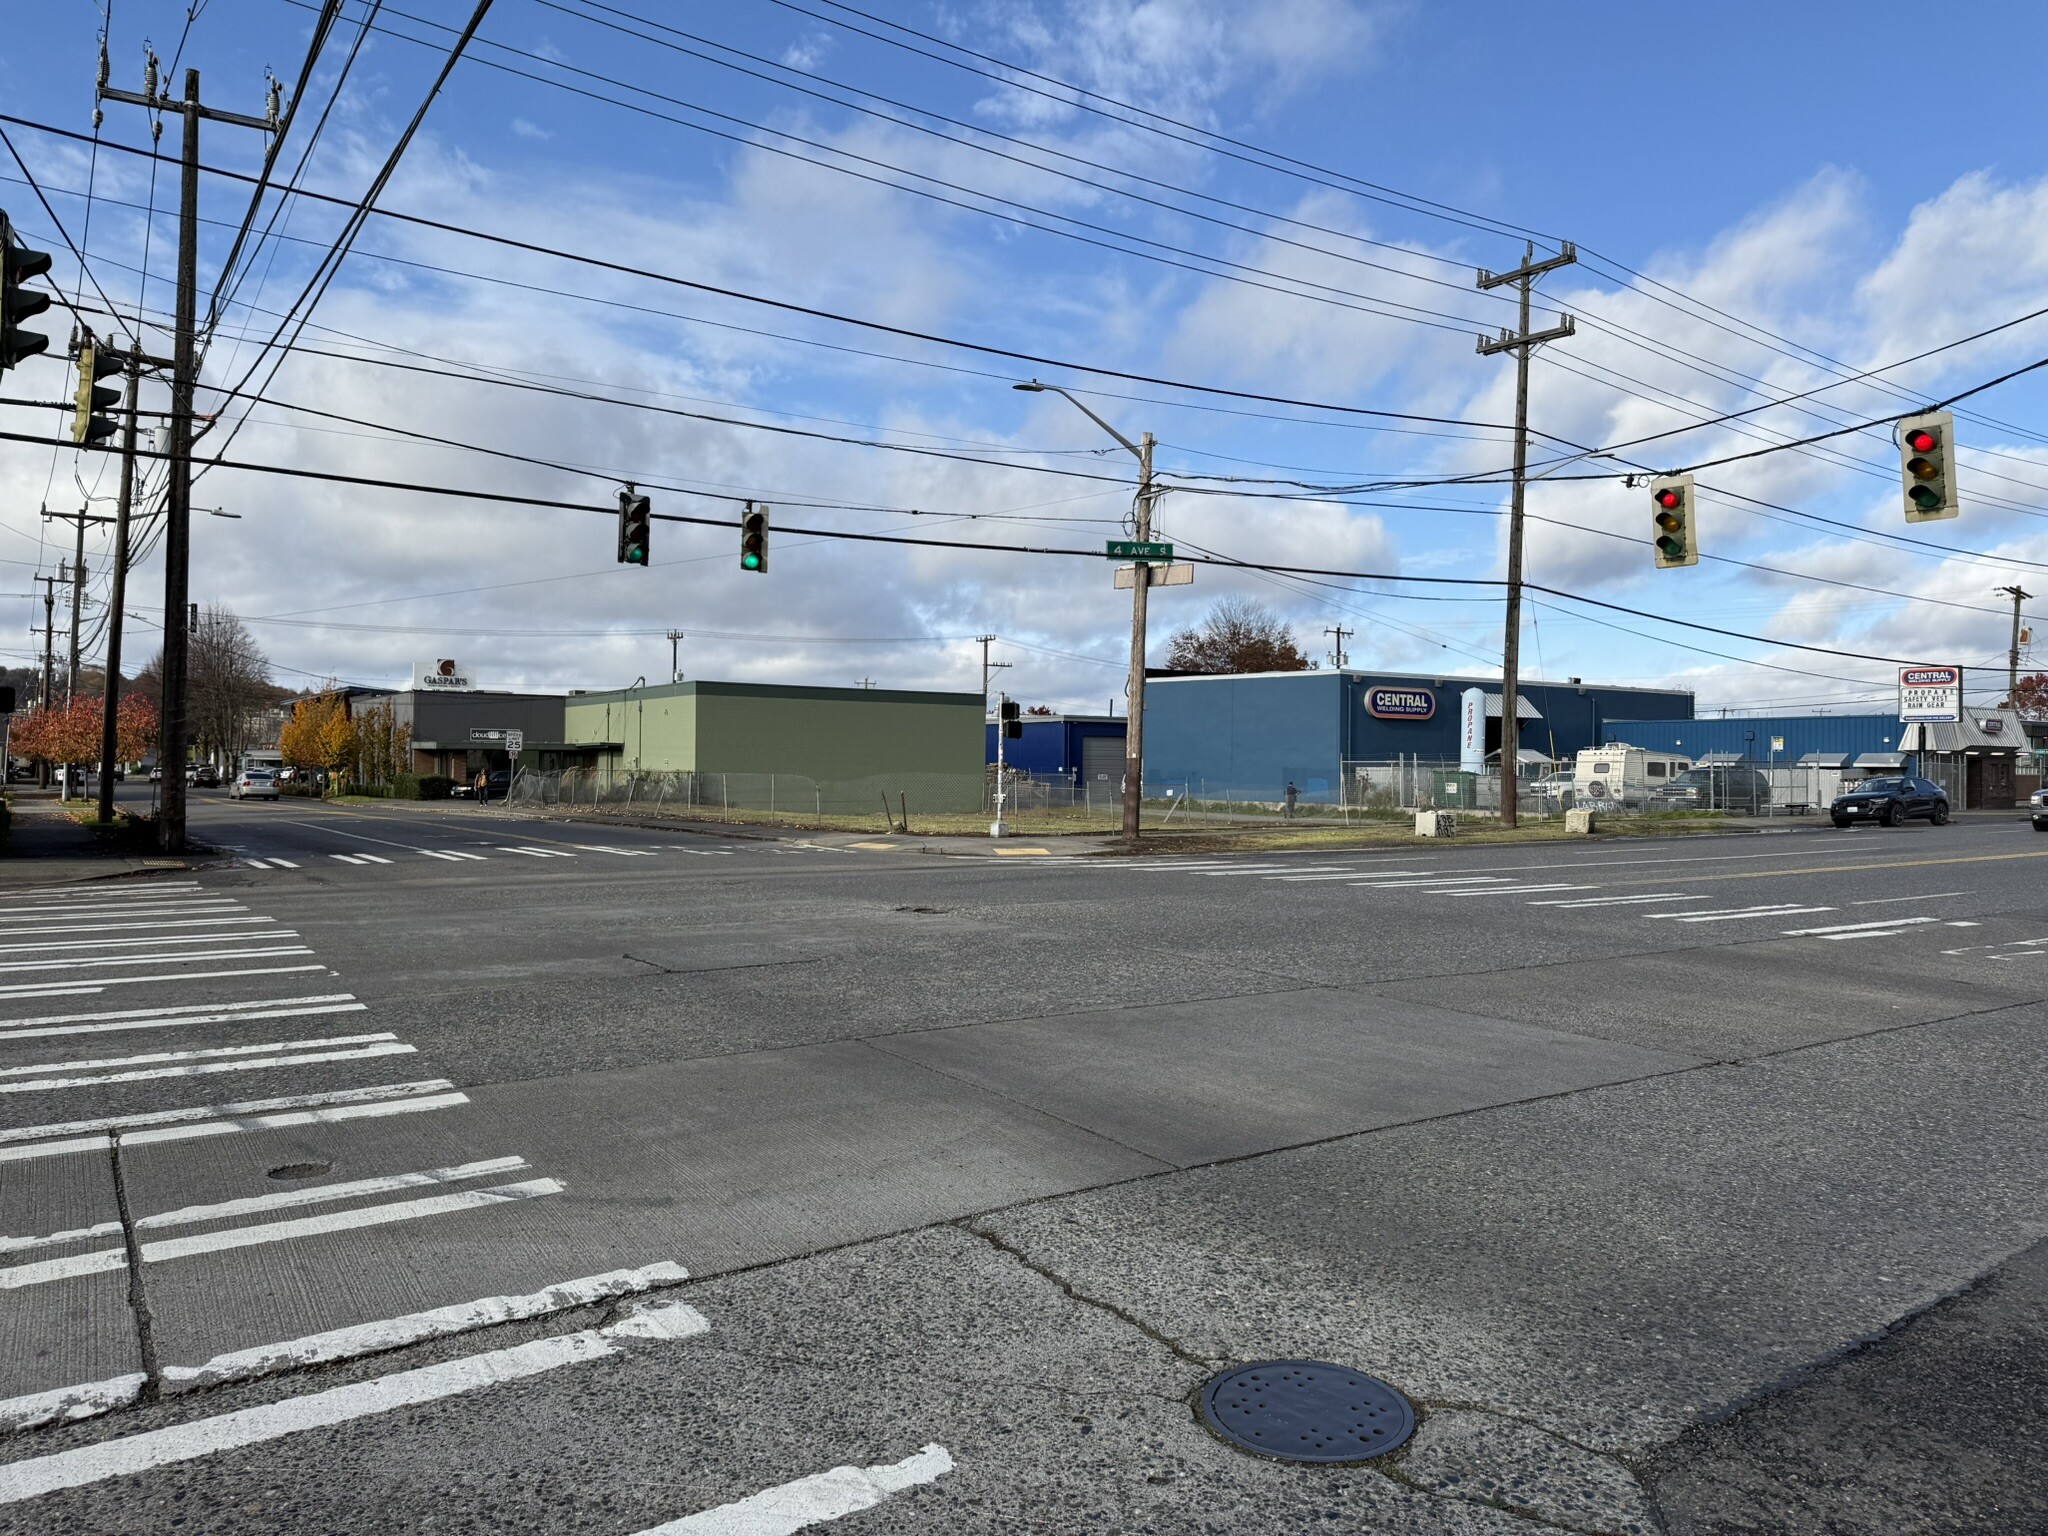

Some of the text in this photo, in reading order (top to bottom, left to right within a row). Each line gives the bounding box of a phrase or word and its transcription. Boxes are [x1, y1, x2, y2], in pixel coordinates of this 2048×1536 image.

[1113, 545, 1167, 557] 4 AVE S
[424, 675, 468, 686] GASPAR'S
[1907, 671, 1952, 680] CENTRAL
[1376, 692, 1428, 708] CENTRAL
[1377, 705, 1405, 713] WELDING
[1466, 702, 1474, 749] PROPANE
[507, 741, 521, 749] 25
